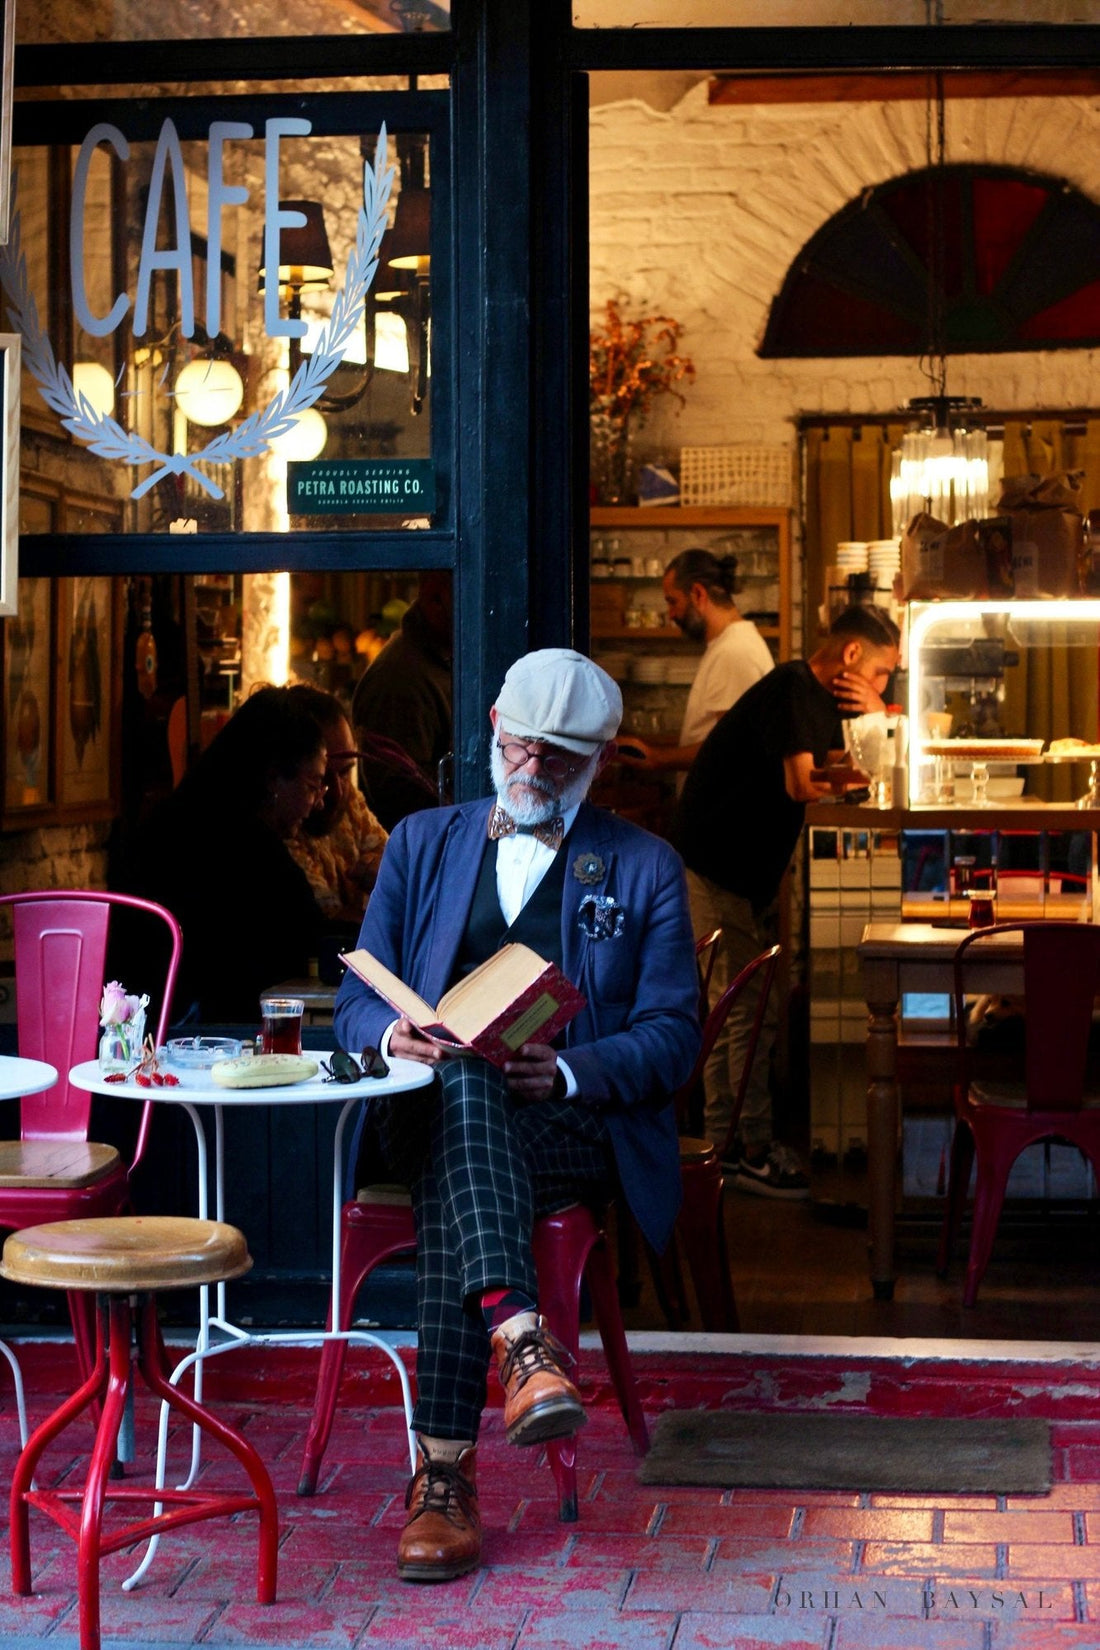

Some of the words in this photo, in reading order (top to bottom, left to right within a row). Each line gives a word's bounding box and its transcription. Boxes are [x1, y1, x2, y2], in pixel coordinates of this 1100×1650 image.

[70, 117, 312, 338] CAFE
[311, 469, 358, 477] PROUDLY
[365, 468, 411, 476] SERVING
[297, 480, 335, 496] PETRA
[340, 479, 399, 495] ROASTING
[404, 479, 424, 494] CO.
